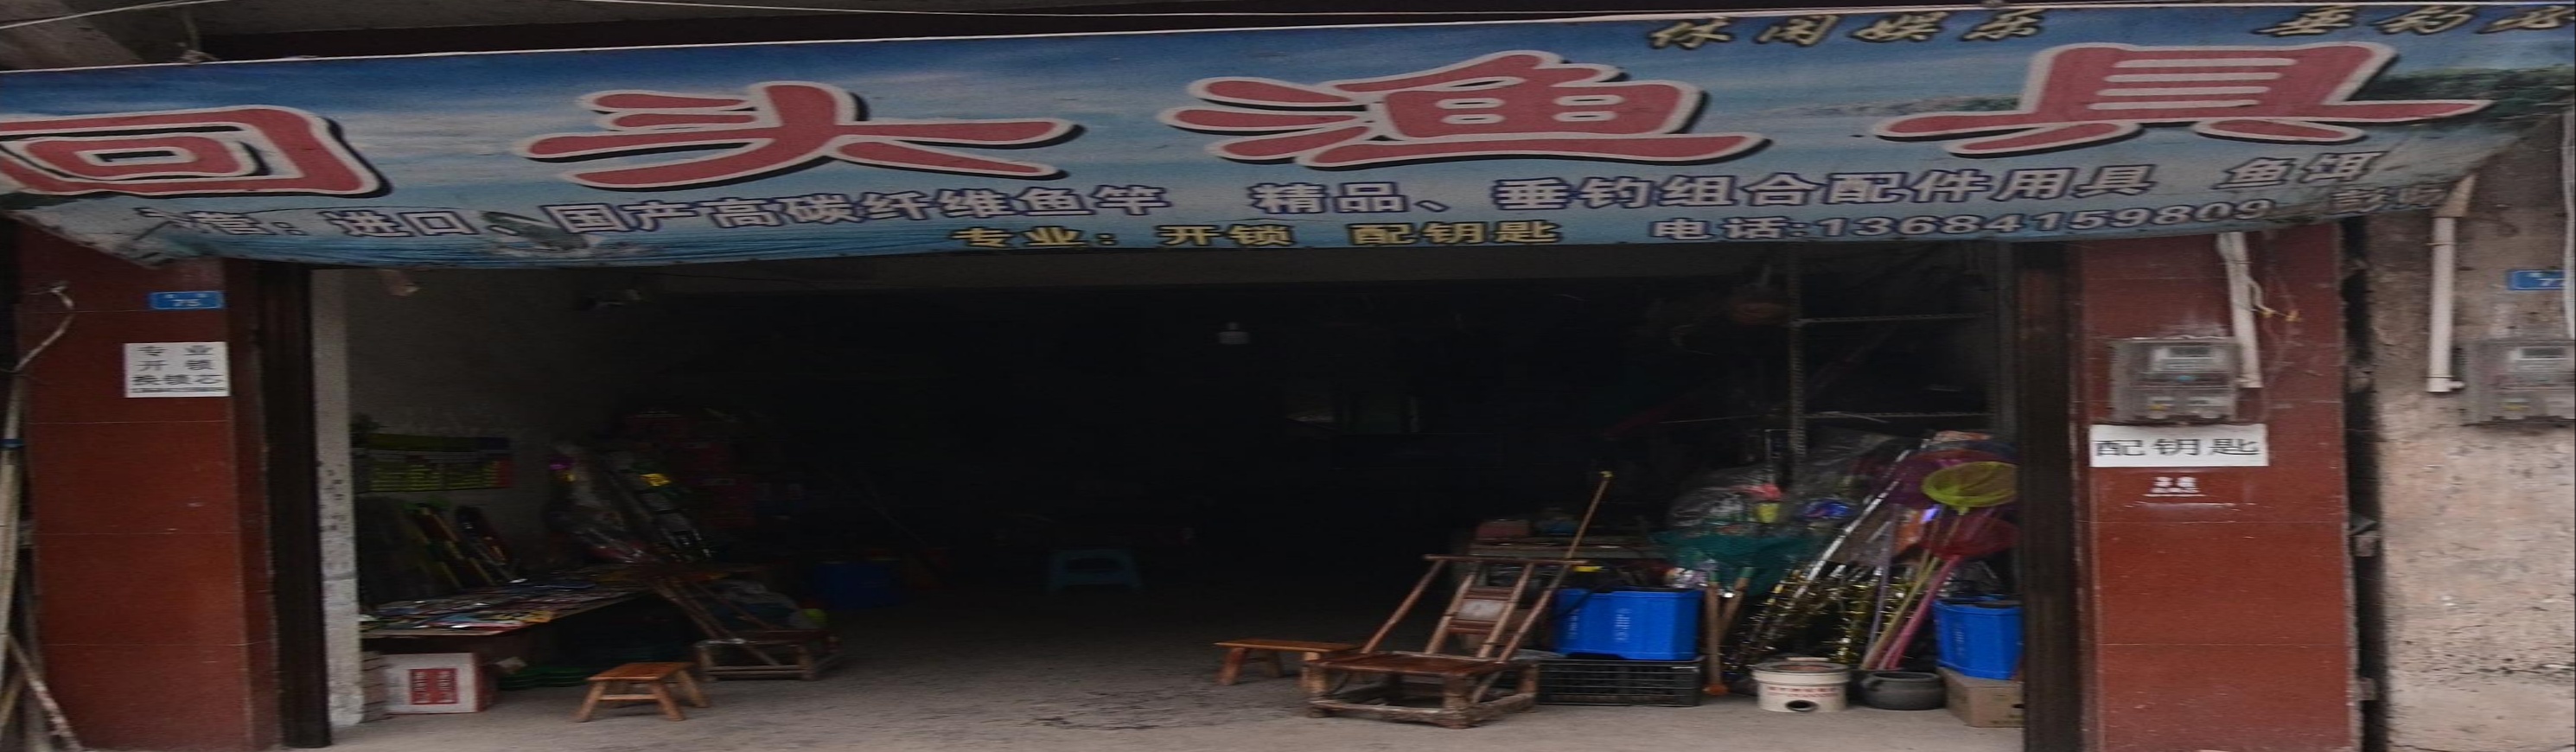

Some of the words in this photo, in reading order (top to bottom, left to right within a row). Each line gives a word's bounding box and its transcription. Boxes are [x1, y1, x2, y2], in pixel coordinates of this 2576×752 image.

[1649, 9, 2047, 49] 休闲娱乐
[0, 40, 2495, 199] 回头渔具
[1349, 220, 1563, 246] 配钥匙
[137, 345, 215, 356] 专业
[136, 360, 215, 371] 开锁
[2092, 437, 2261, 457] 配钥匙
